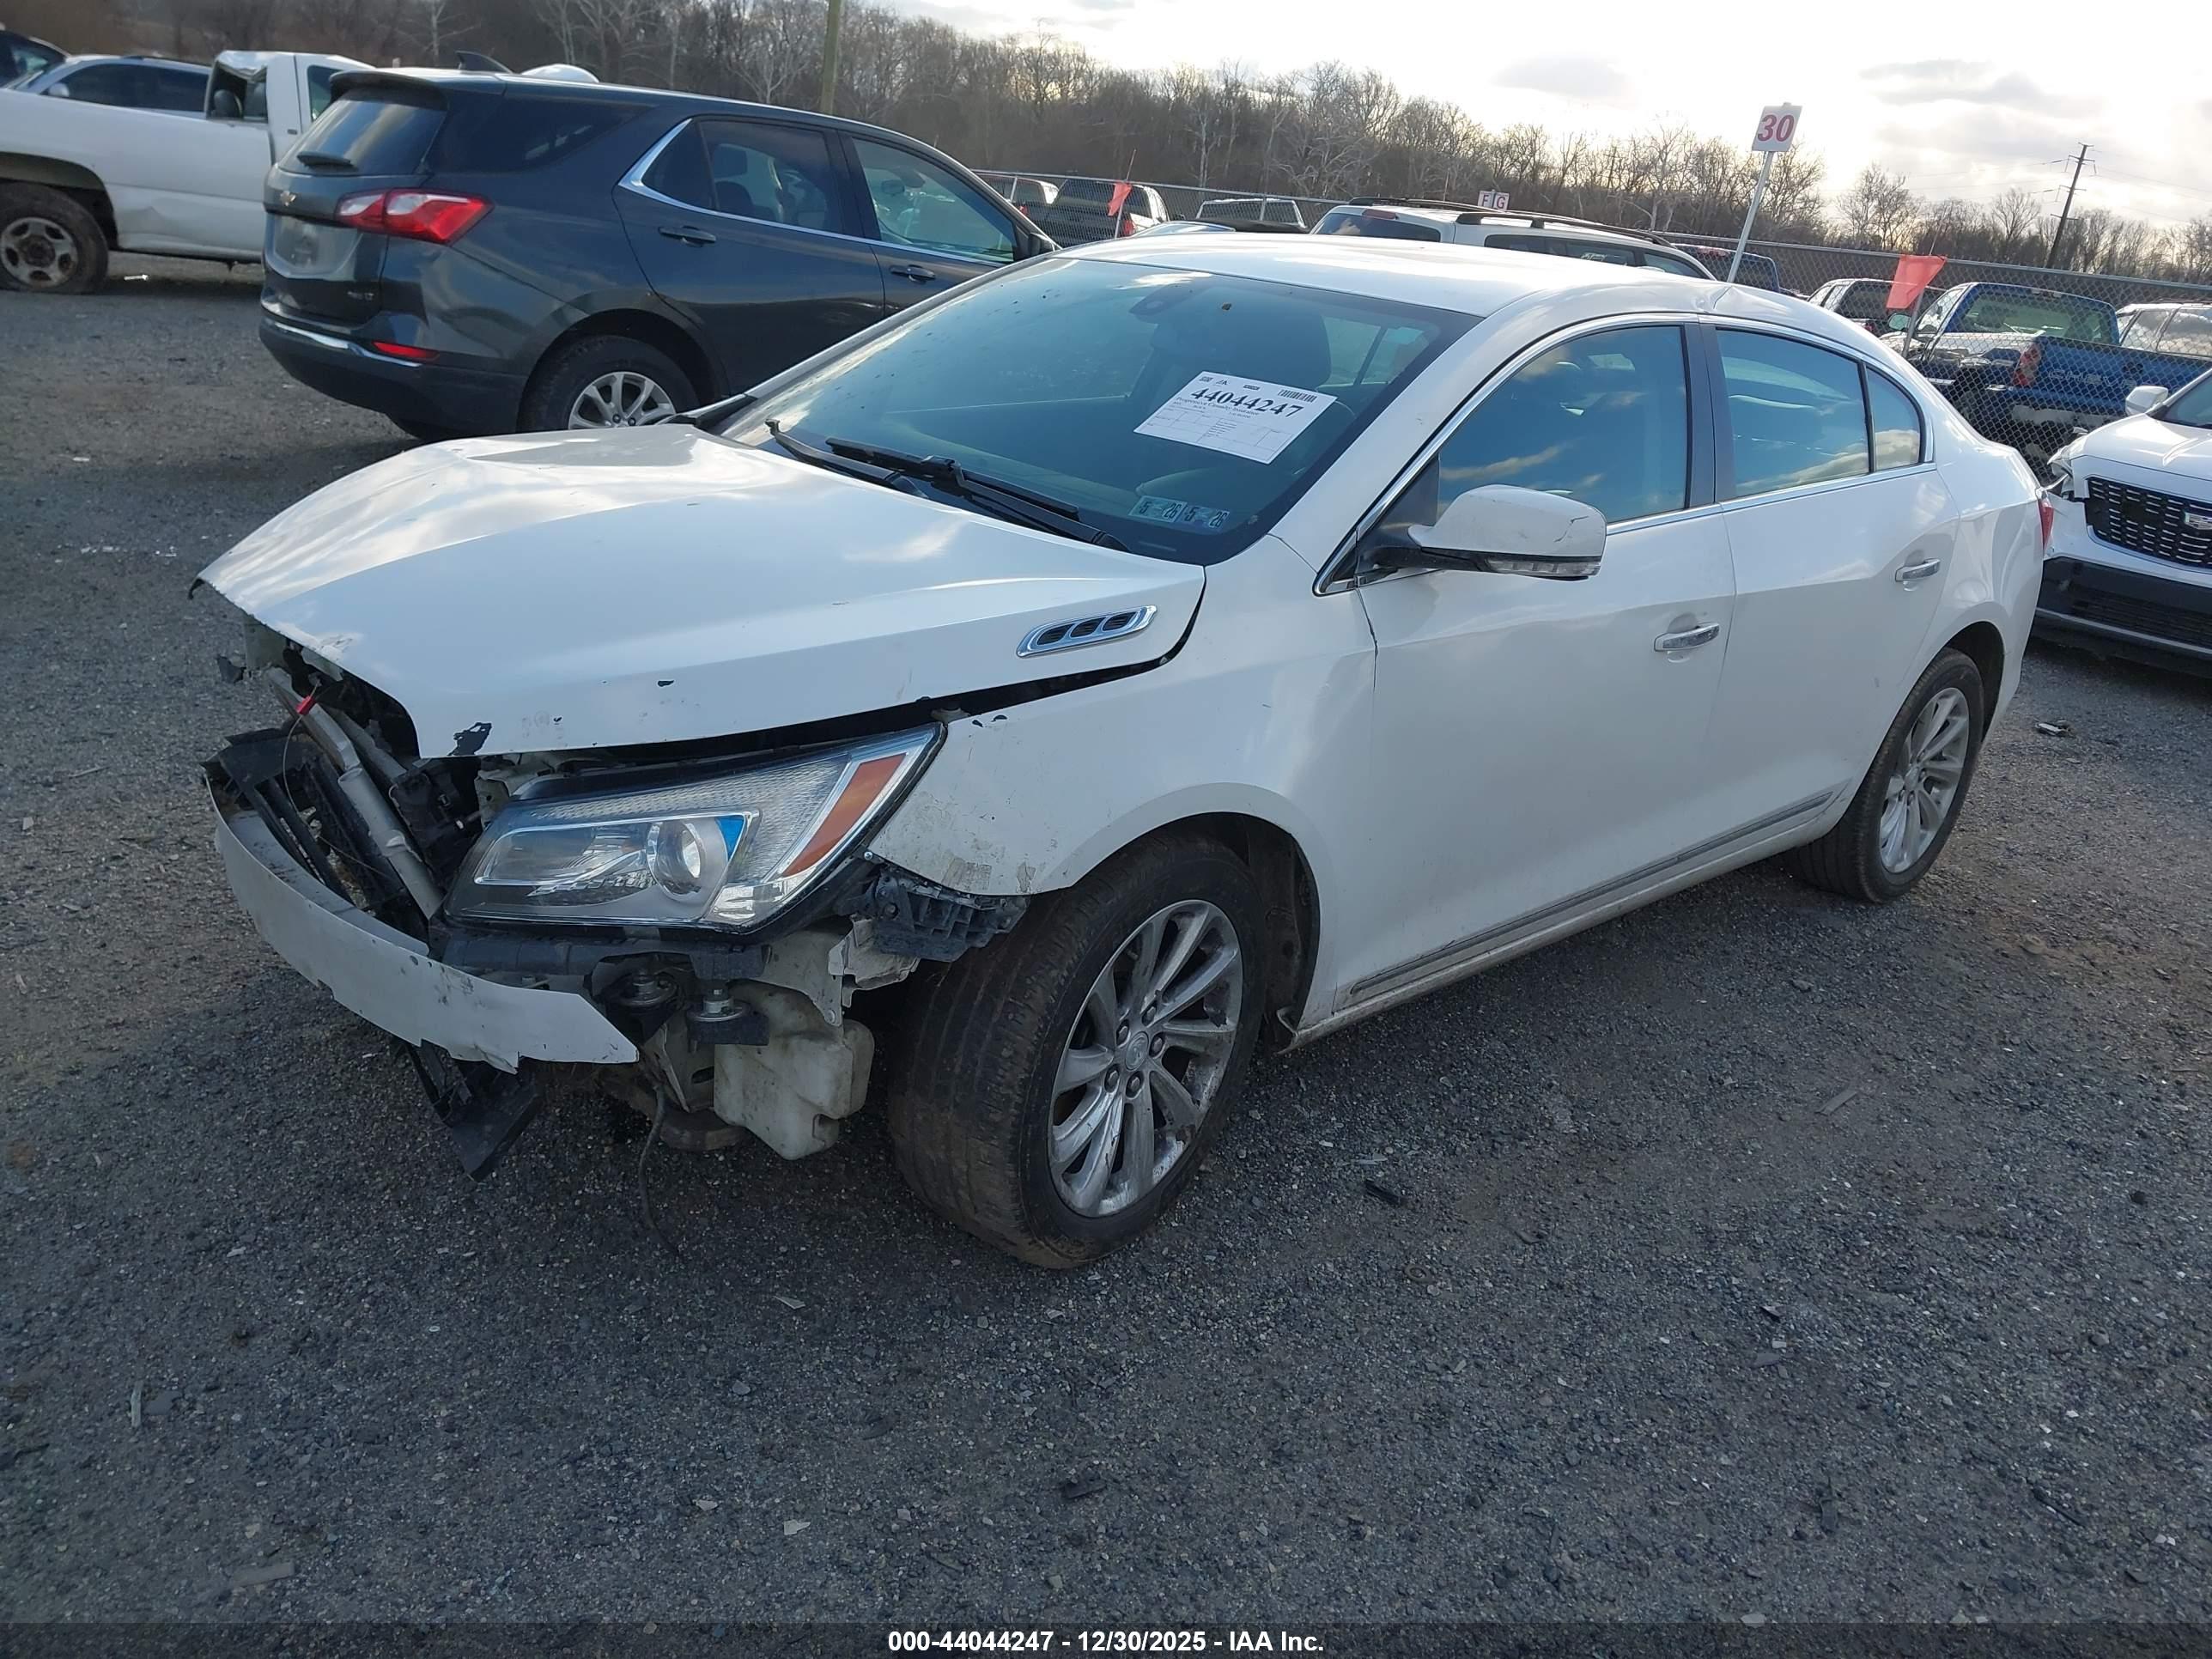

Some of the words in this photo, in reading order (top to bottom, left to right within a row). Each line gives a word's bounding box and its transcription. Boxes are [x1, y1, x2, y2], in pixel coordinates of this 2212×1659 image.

[1758, 114, 1795, 142] 30
[1482, 194, 1490, 207] F
[1497, 196, 1506, 210] G
[1191, 388, 1304, 417] 44044247
[1164, 502, 1182, 520] 26
